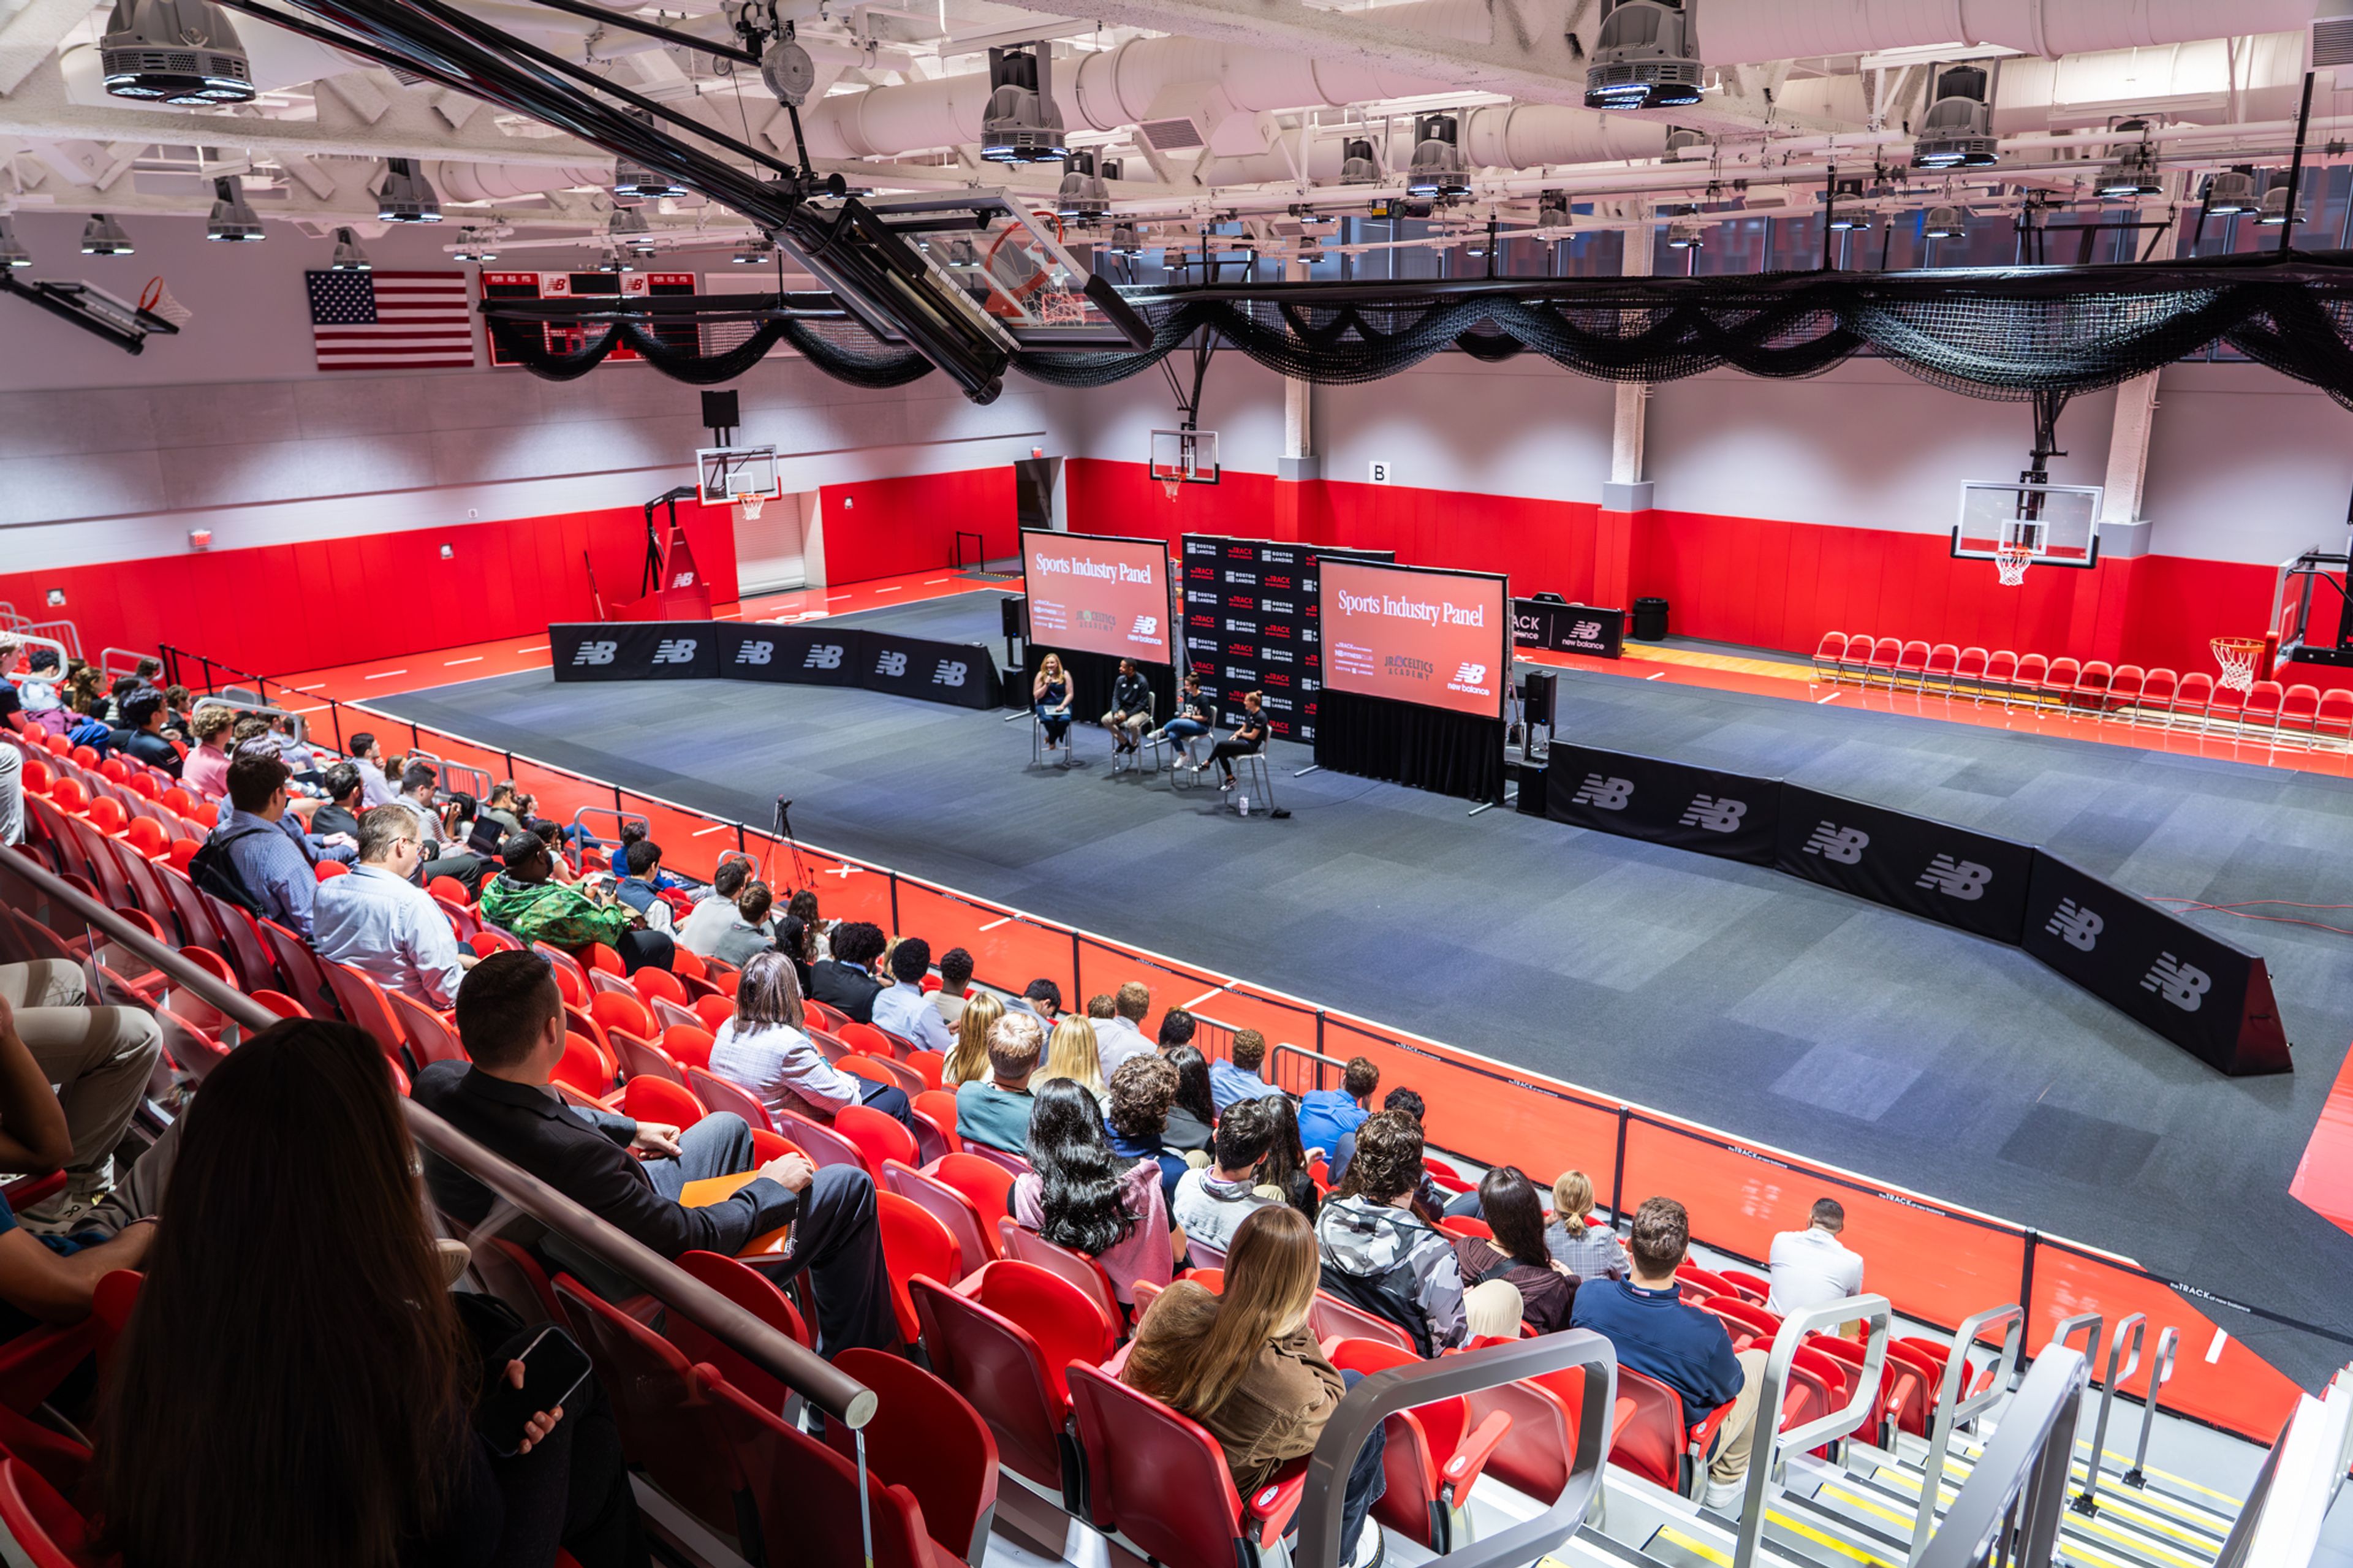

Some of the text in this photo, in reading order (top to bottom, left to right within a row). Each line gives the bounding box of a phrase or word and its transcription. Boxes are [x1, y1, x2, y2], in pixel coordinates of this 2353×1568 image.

[1374, 465, 1385, 480] B
[672, 572, 694, 589] NB
[1036, 553, 1152, 584] Sports Industry Panel
[1338, 589, 1483, 627] Sports Industry Panel
[1132, 615, 1158, 635] NB
[1513, 615, 1540, 630] ACK
[1569, 620, 1602, 640] NB
[572, 641, 617, 665] NB
[652, 639, 697, 664] NB
[735, 640, 774, 665] NB
[803, 644, 844, 669] NB
[1576, 640, 1604, 650] balance
[874, 650, 907, 676] NB
[932, 659, 968, 687] NB
[1389, 668, 1430, 681] ACADEMY
[1403, 657, 1433, 674] CELTICS
[1453, 662, 1486, 684] NB
[1461, 683, 1490, 696] balance
[1572, 773, 1634, 811] NB
[1678, 793, 1748, 833] NB
[1802, 820, 1870, 865] NB
[1915, 853, 1993, 901] NB
[2045, 897, 2104, 952] NB
[2139, 951, 2211, 1012] NB
